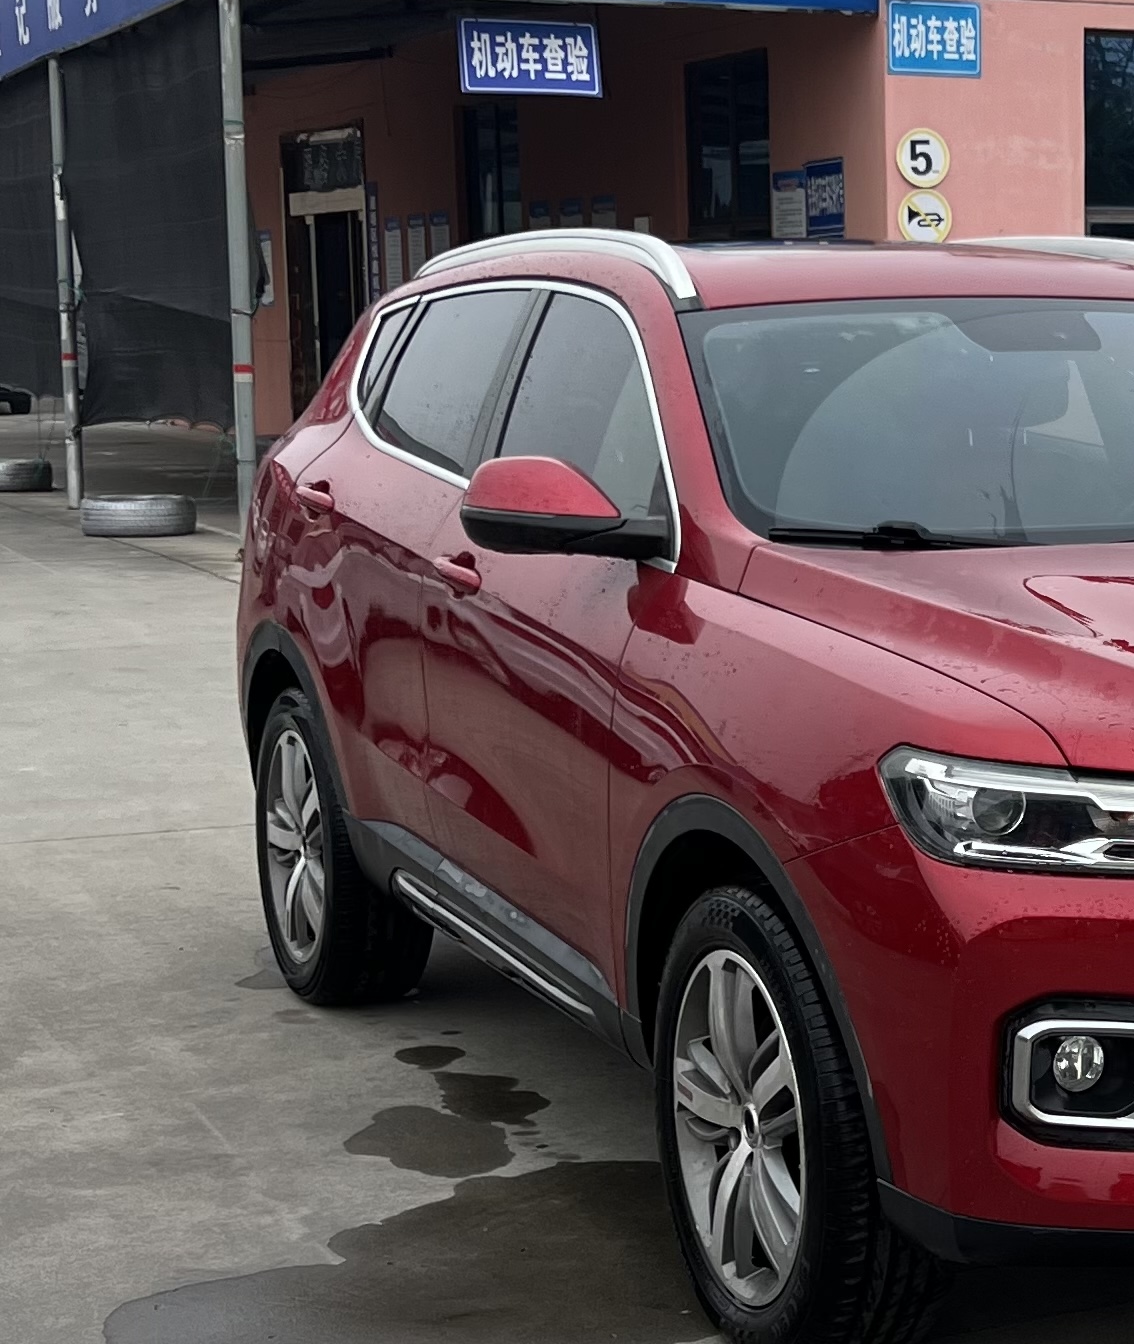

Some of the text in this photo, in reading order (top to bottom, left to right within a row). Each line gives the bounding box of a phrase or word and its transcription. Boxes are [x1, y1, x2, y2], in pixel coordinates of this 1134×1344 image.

[470, 31, 591, 83] 机动车查验
[892, 14, 976, 62] 机动车查验
[909, 139, 933, 176] 5
